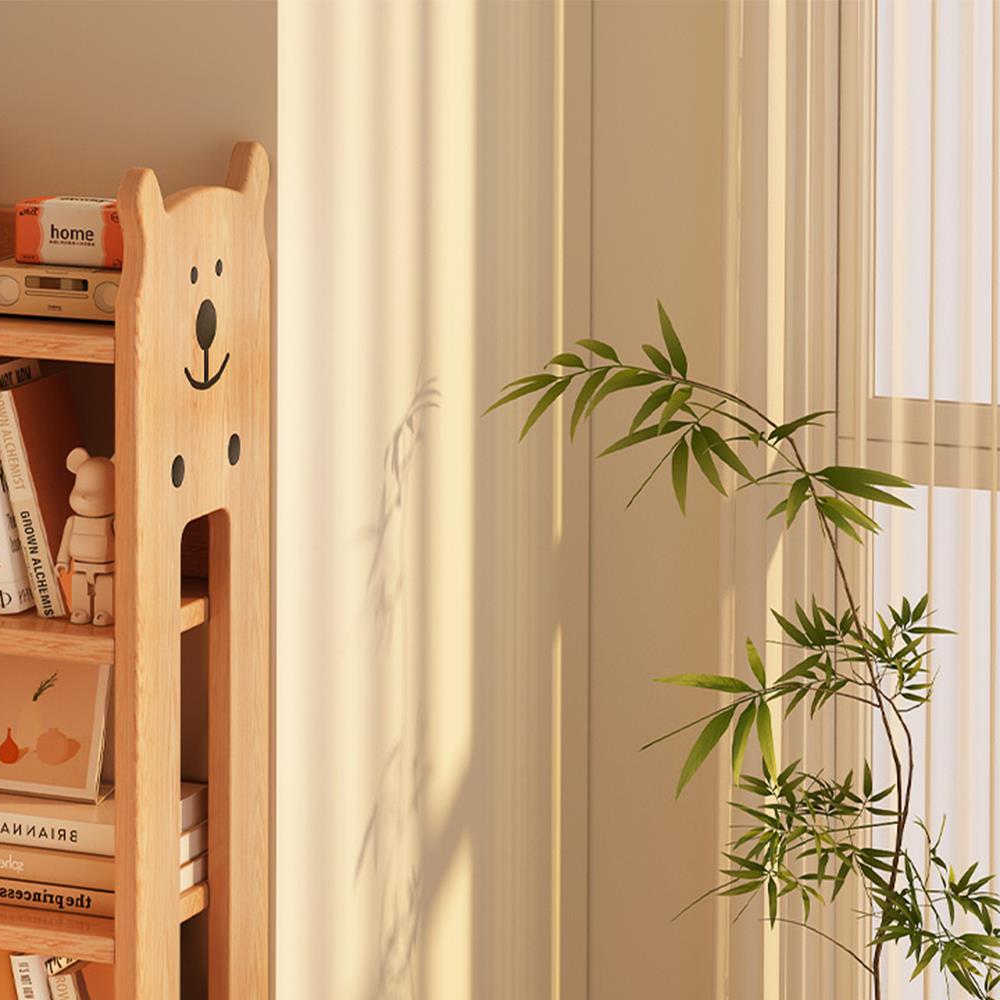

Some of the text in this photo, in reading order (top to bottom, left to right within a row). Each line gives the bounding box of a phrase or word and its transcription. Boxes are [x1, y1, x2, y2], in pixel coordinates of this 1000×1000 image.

[51, 224, 94, 241] home
[1, 430, 26, 490] ALCHEMIST
[20, 511, 39, 555] GROWN
[32, 558, 55, 618] ALCHEMIS
